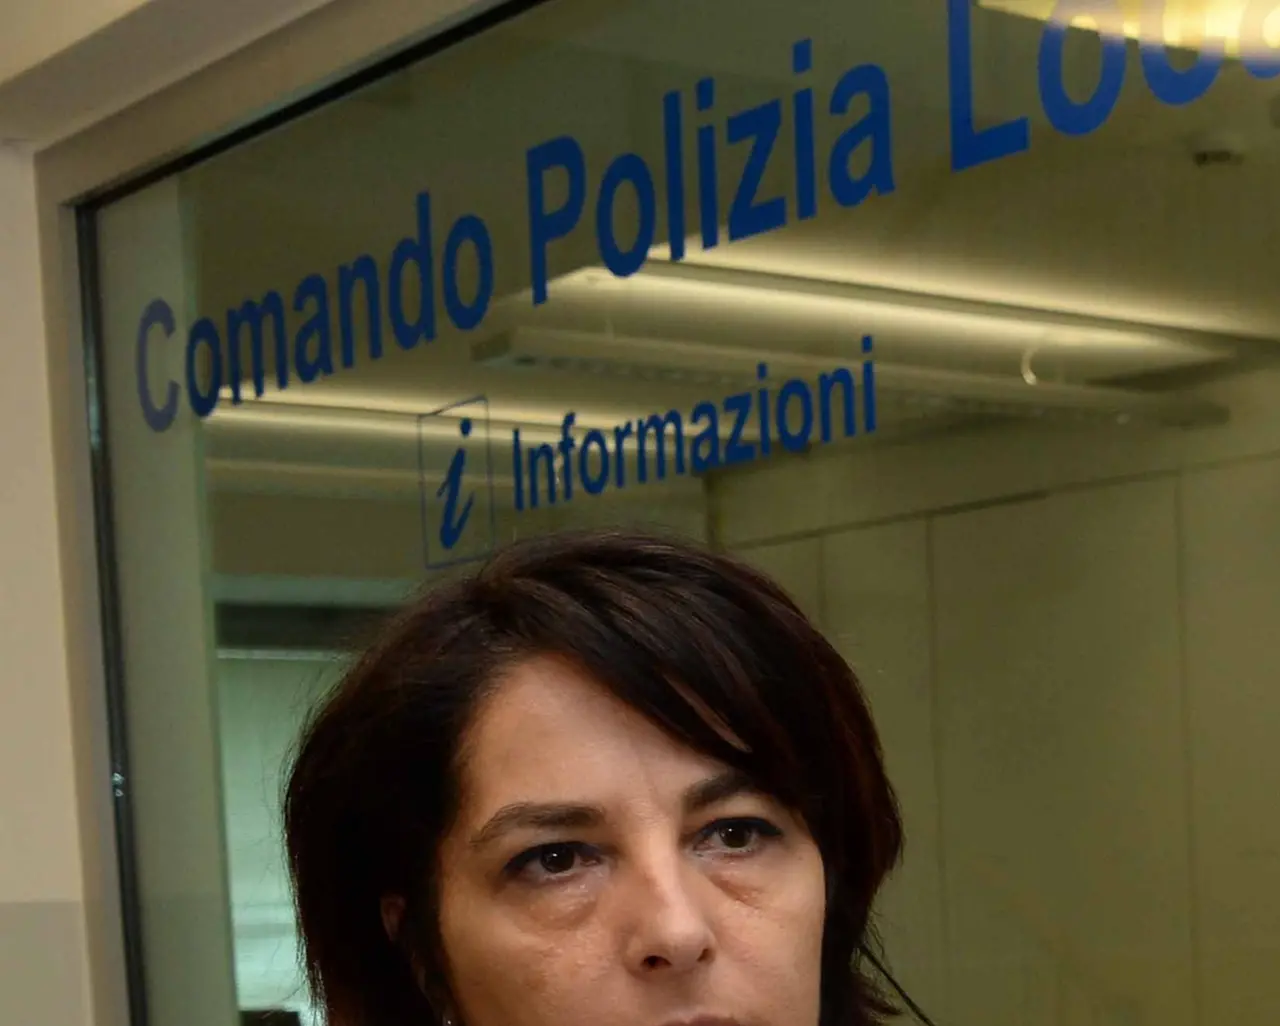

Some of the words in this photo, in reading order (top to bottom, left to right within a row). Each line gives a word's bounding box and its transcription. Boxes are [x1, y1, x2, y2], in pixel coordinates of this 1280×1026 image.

[136, 190, 493, 433] Comando
[527, 38, 896, 305] Polizia
[512, 336, 878, 511] Informazioni
